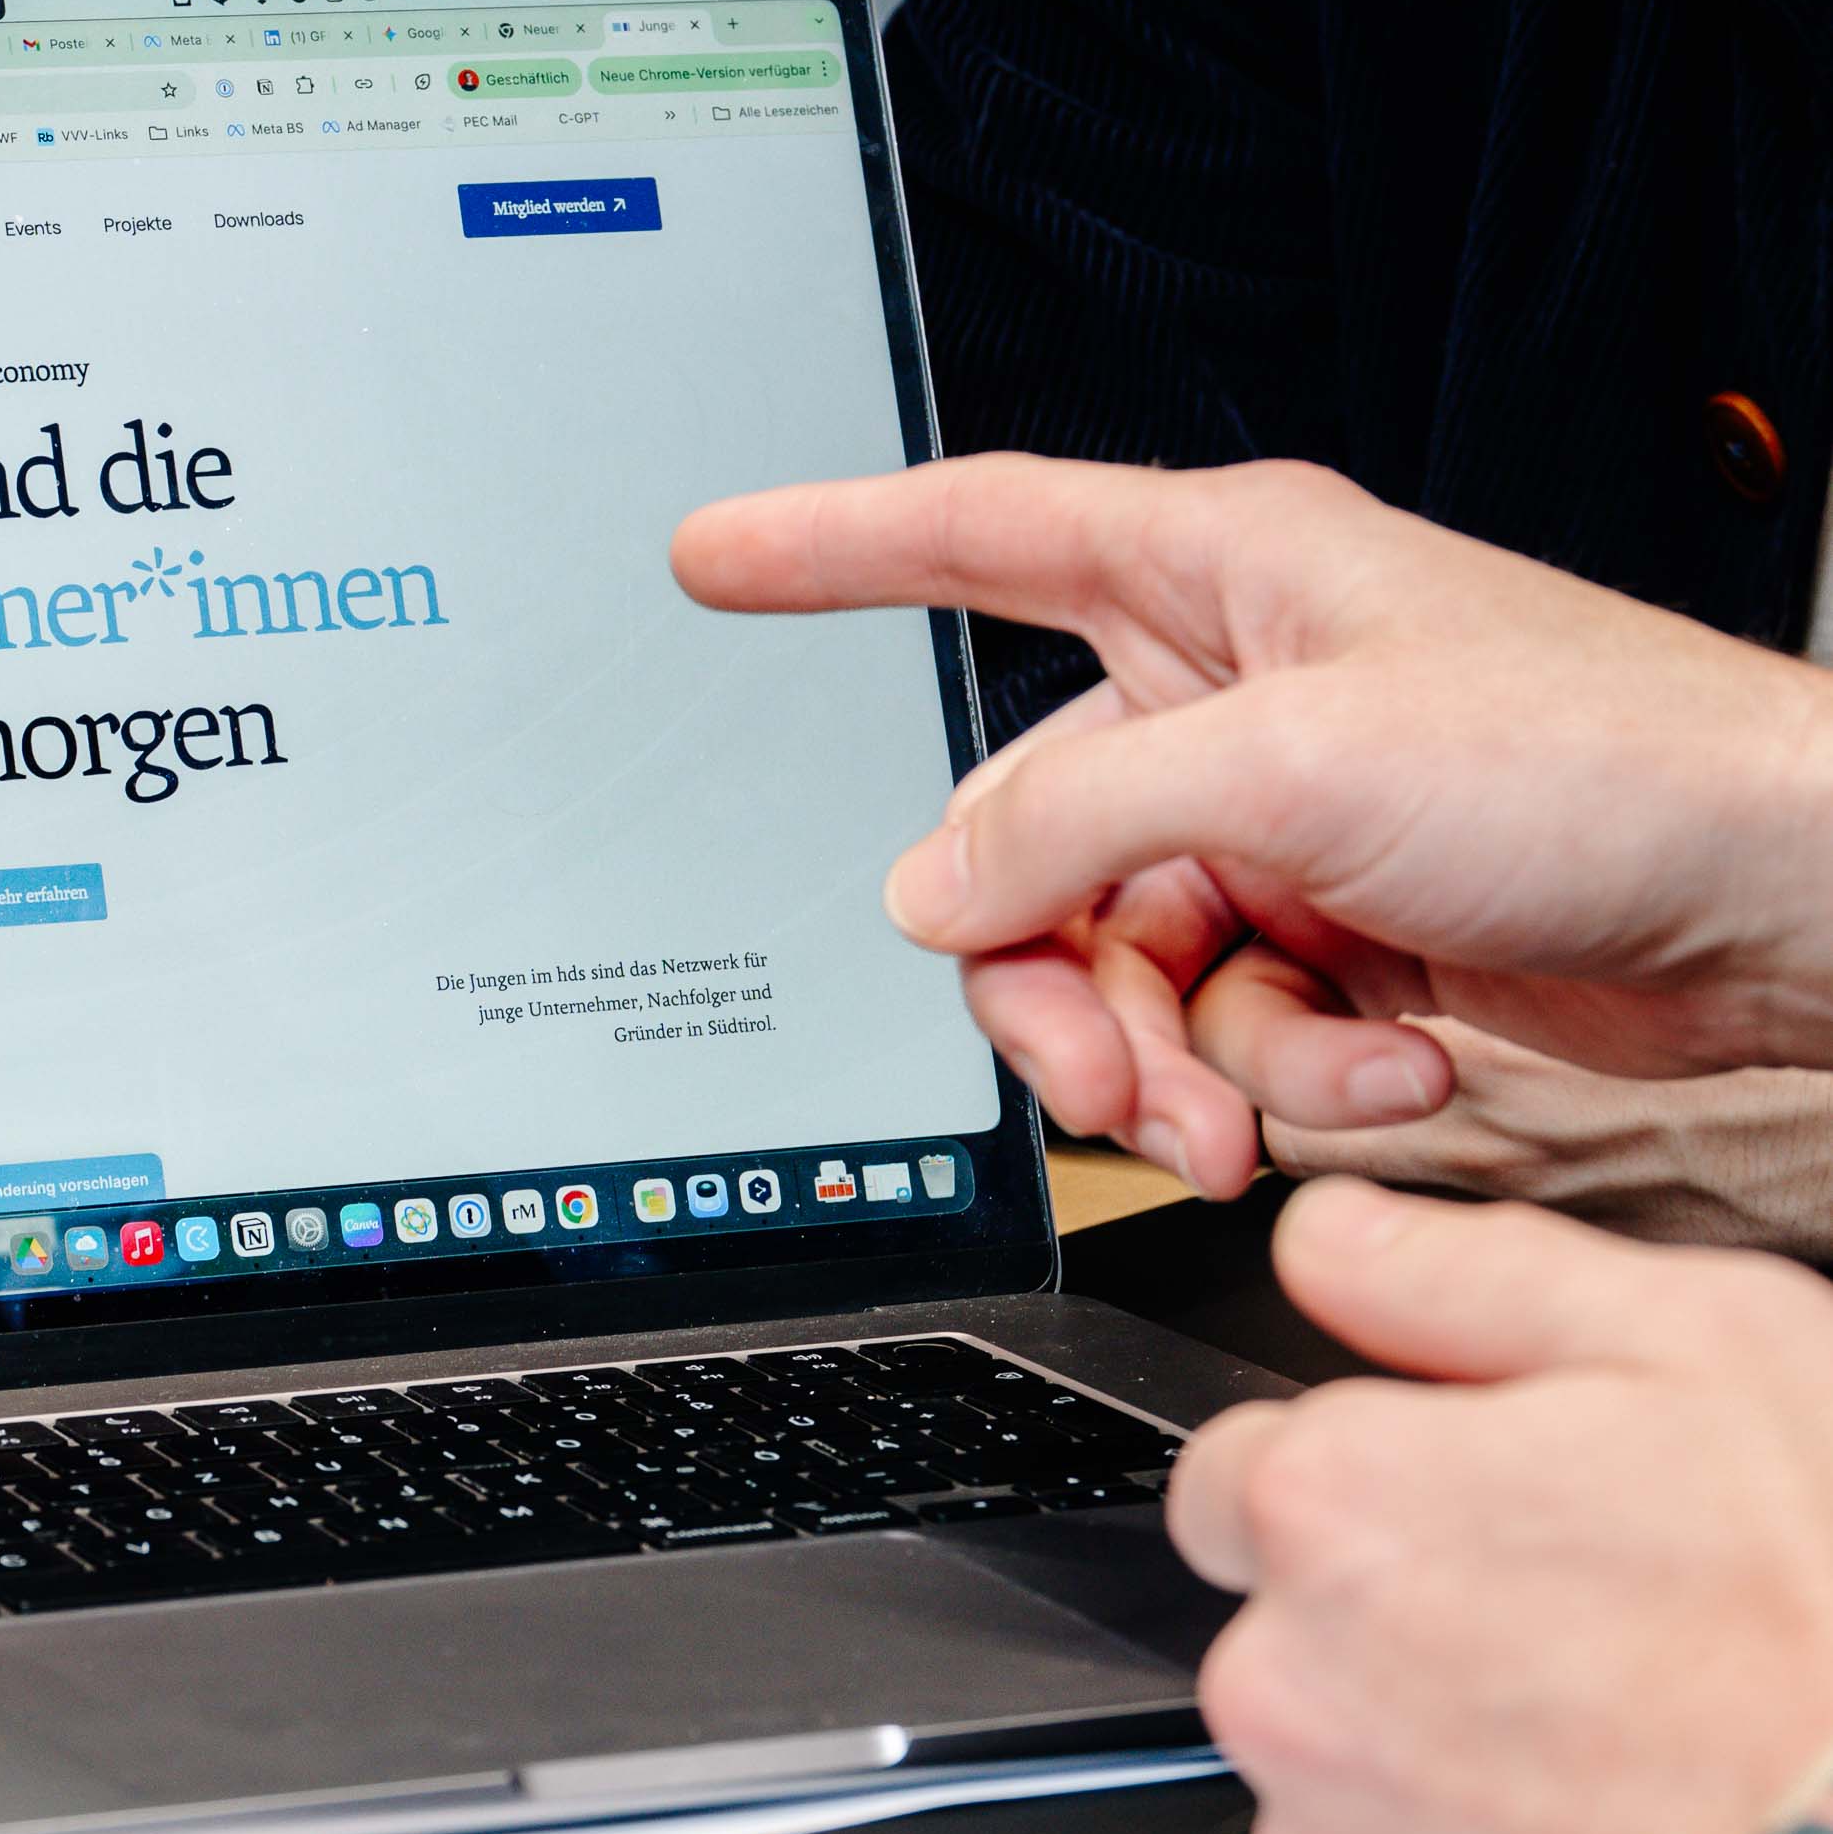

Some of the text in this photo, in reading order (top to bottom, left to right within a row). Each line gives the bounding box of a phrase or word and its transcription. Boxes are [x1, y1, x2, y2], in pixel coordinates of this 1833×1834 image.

[171, 35, 202, 45] Meta
[291, 31, 305, 45] (1)
[486, 71, 569, 86] Geschäftlich
[601, 64, 811, 82] Neue Chrome-Version verfügbar
[559, 112, 599, 124] C-GPT
[739, 104, 838, 118] Alle Lesezeichen
[252, 122, 303, 134] Meta BS
[347, 120, 420, 132] Ad Manager
[464, 115, 517, 127] PEC Mail
[62, 129, 128, 141] VVV-Links
[176, 126, 209, 137] Links
[493, 197, 605, 219] Mitglied werden
[104, 217, 172, 236] Projekte
[214, 211, 304, 228] Downloads
[5, 221, 61, 236] Events
[100, 419, 235, 514] die
[26, 885, 89, 903] erfahren
[436, 952, 767, 993] Die Jungen im hds sind das Netzwerk für
[479, 983, 772, 1026] junge Unternehmer, Nachfolger und
[614, 1015, 776, 1042] Gründer in Südtirol.
[59, 1175, 149, 1192] vorschlagen
[512, 1204, 536, 1219] rM
[345, 1220, 379, 1232] Canva
